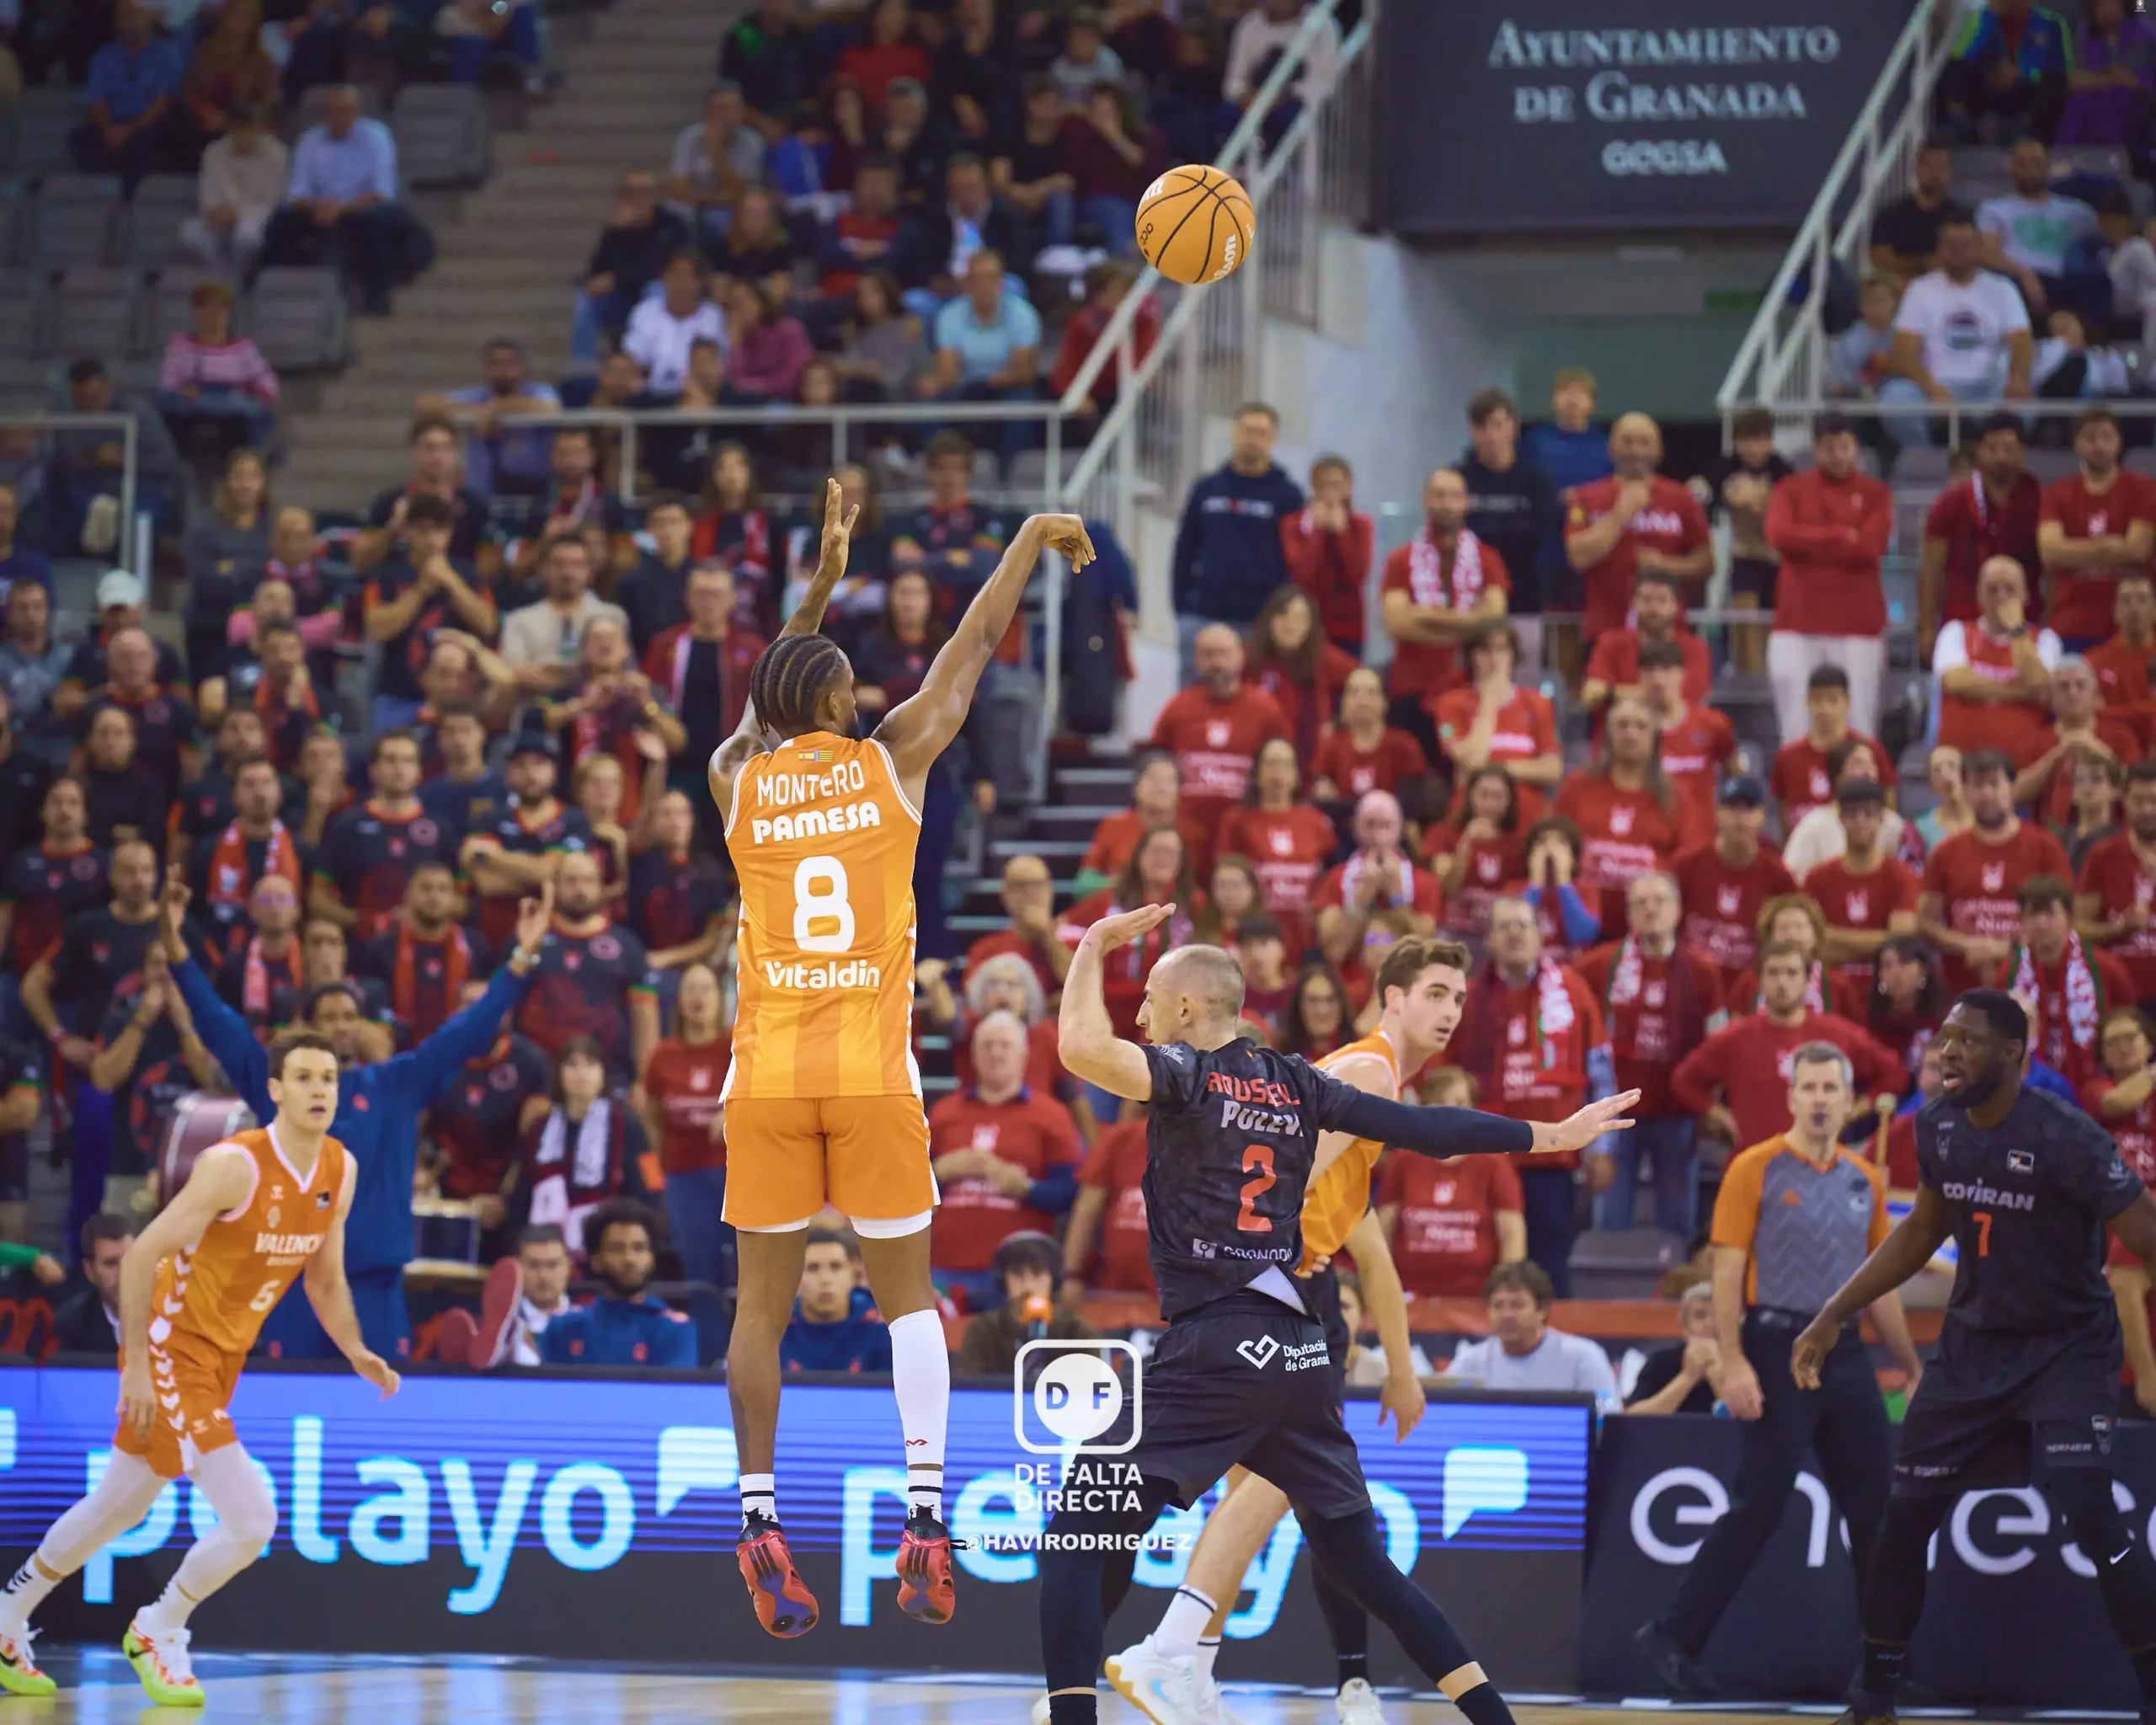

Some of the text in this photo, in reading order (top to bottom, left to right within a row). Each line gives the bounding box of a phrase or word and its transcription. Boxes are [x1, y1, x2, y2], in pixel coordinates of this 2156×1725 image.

[1487, 18, 1841, 68] AYUNTAMIENTO
[1513, 70, 1806, 122] DE GRANADA
[757, 760, 865, 807] MONTERO
[752, 801, 881, 845] PAMESA
[793, 855, 855, 953] 8
[765, 959, 880, 990] Vitaldin
[1237, 1144, 1277, 1232] 2
[1972, 1211, 1993, 1258] 7
[1285, 1359, 1298, 1372] de
[840, 1434, 1419, 1639] peay
[1630, 1466, 2156, 1578] ene
